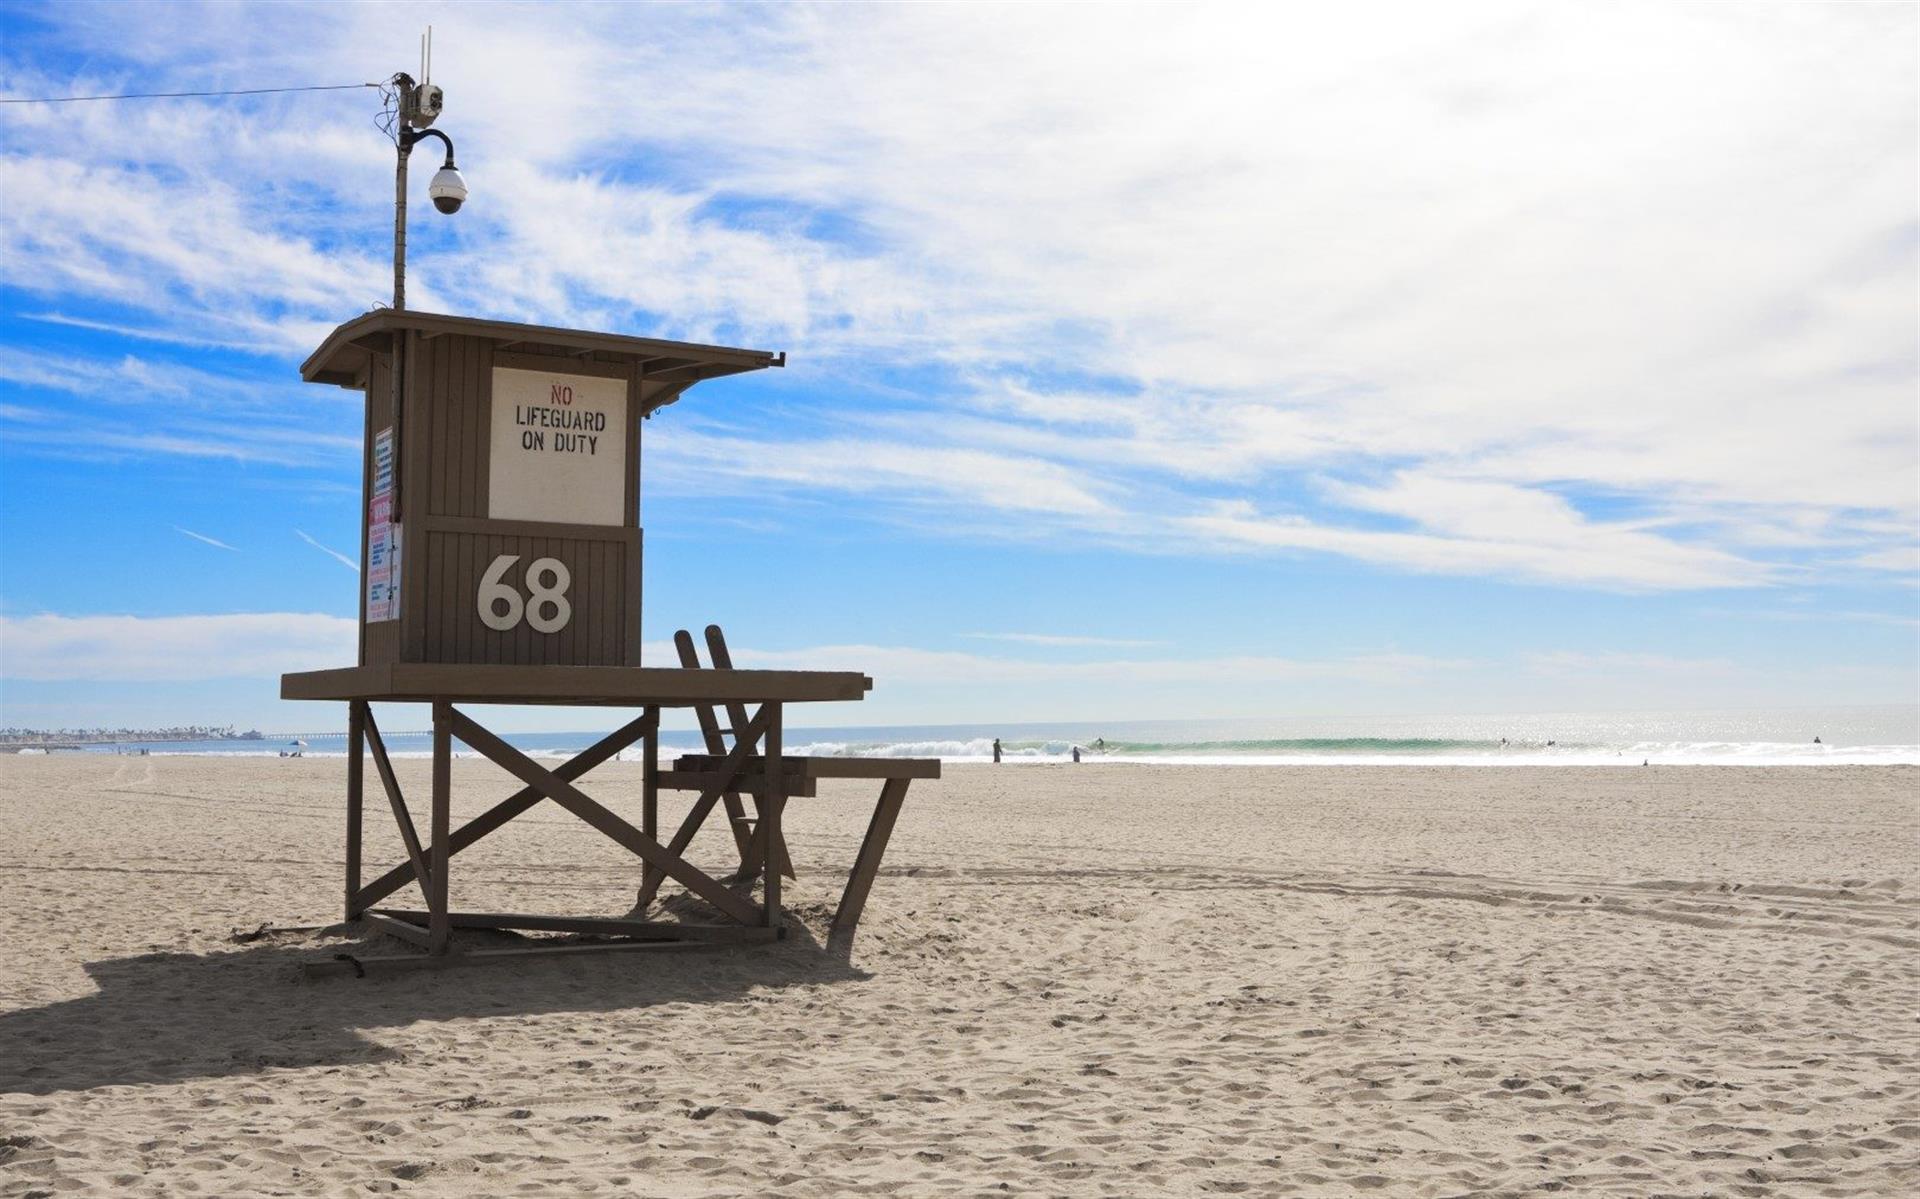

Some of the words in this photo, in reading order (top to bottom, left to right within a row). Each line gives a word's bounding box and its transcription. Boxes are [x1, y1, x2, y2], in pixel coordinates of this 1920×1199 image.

[551, 384, 573, 406] NO
[516, 405, 606, 432] LIFEGUARD
[522, 430, 544, 451] ON
[554, 433, 598, 456] DUTY
[477, 554, 571, 633] 68
